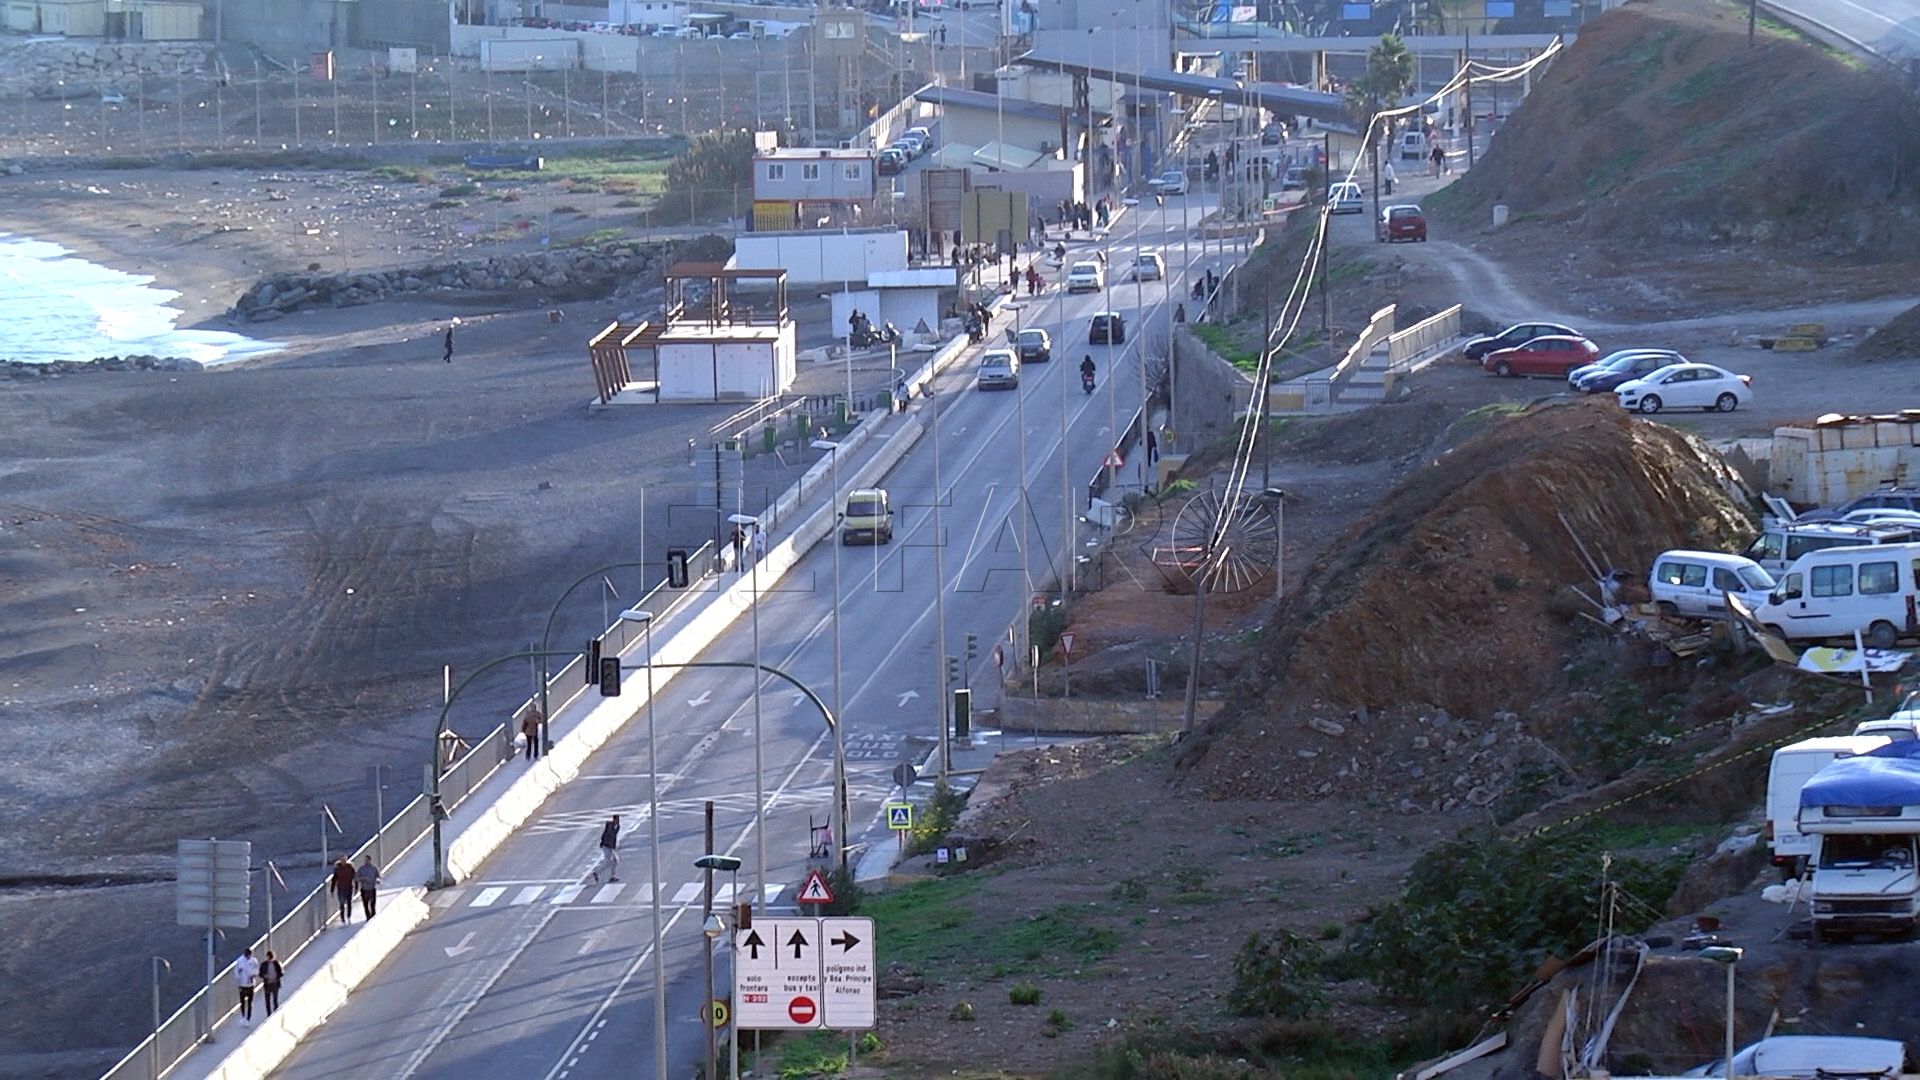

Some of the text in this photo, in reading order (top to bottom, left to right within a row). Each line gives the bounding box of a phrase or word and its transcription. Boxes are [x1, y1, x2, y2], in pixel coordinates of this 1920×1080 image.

[846, 733, 906, 741] TAXI
[844, 742, 897, 750] BUS
[787, 974, 816, 983] excepto
[783, 984, 797, 992] bus
[805, 984, 820, 992] taxi
[835, 986, 861, 994] Alfonso
